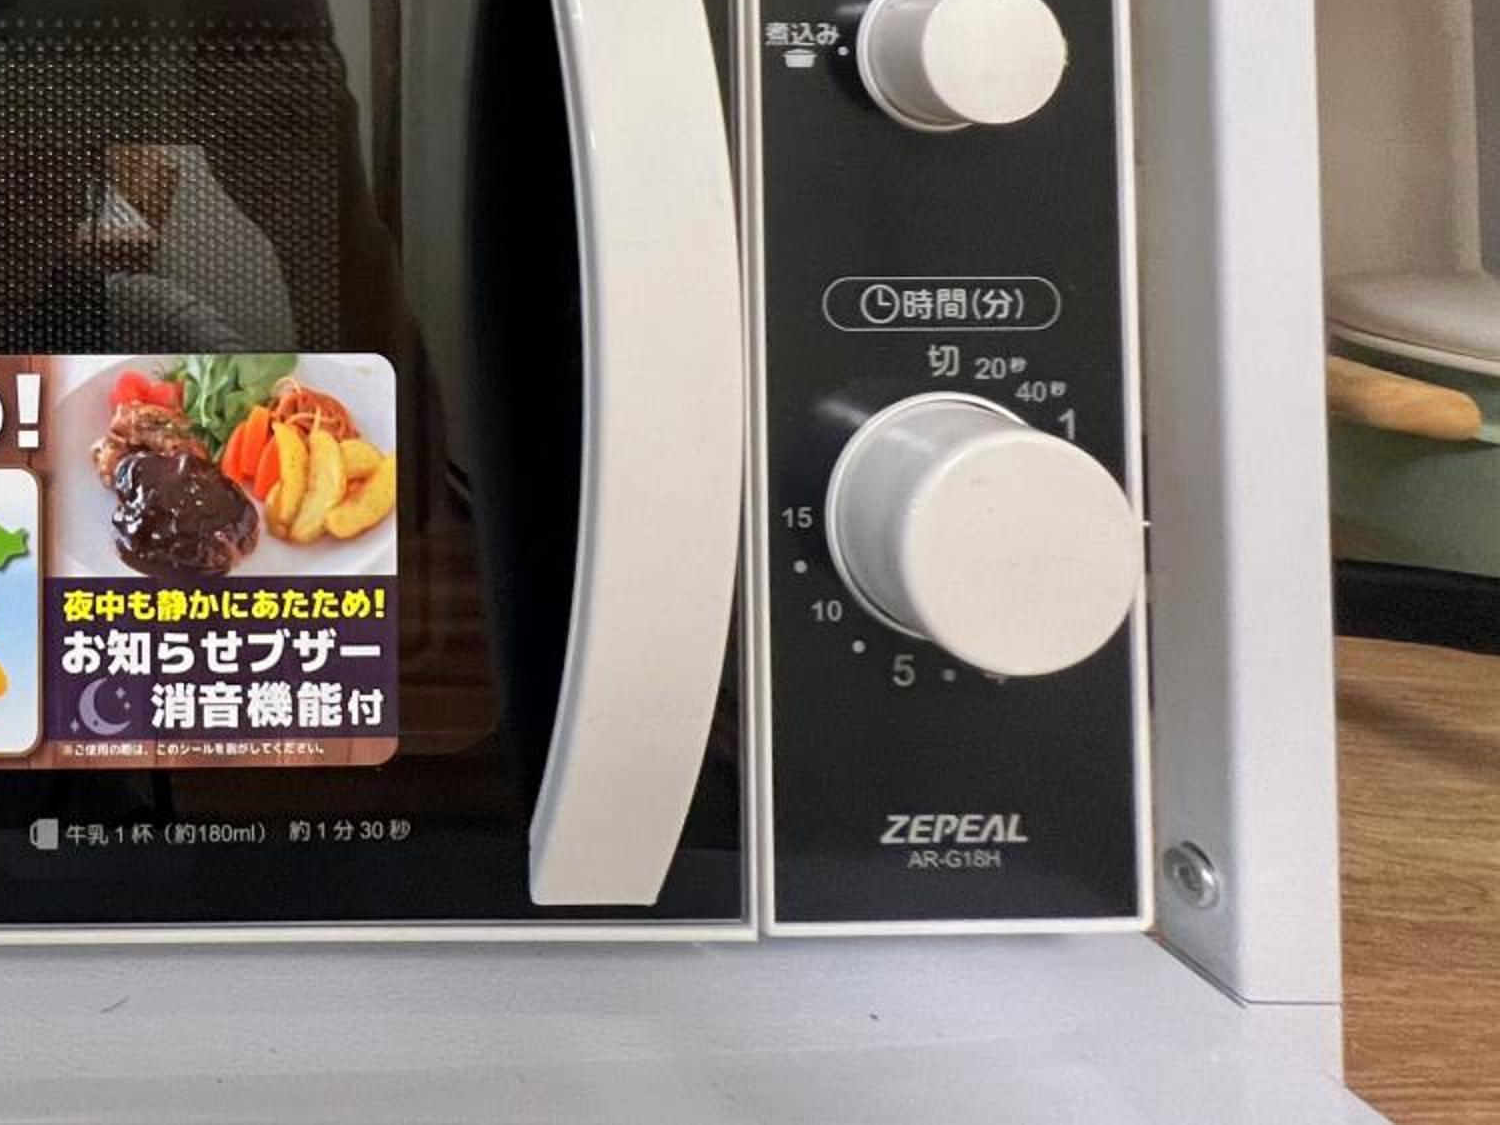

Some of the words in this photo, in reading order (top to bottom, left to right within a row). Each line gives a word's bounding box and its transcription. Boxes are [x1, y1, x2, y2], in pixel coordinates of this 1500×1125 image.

[765, 22, 840, 46] 煮込み
[902, 288, 1025, 321] 時間(分)
[927, 344, 960, 377] 切
[974, 357, 1027, 381] 20秒
[1015, 380, 1067, 402] 40秒
[1057, 408, 1077, 441] 1
[781, 506, 813, 528] 15
[63, 589, 386, 623] 夜中も静かにあたため！
[810, 600, 844, 622] 10
[61, 628, 382, 676] お知らせブザー
[892, 654, 917, 688] 5
[150, 682, 385, 729] 消音機能付
[879, 813, 1030, 845] ZEPEAL
[906, 849, 1002, 870] AR-G18H
